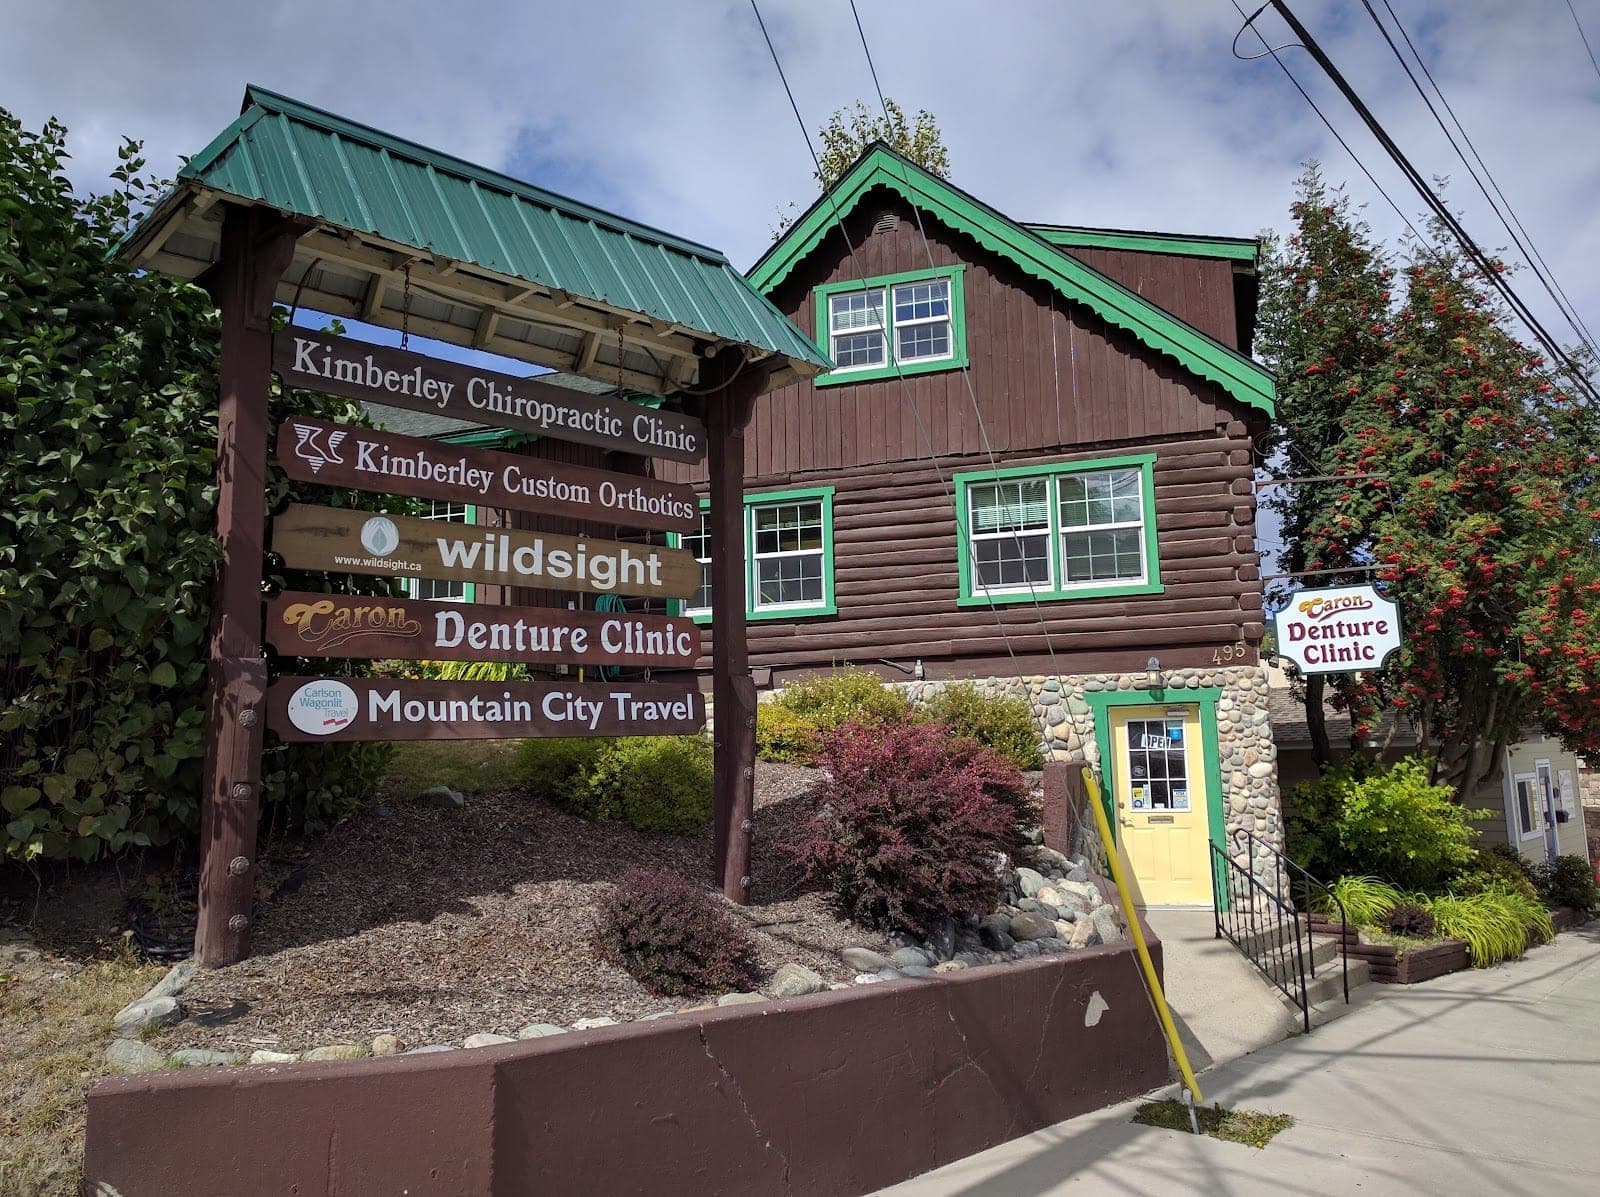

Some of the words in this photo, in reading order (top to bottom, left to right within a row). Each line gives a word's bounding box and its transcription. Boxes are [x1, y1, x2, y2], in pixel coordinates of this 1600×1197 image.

[292, 337, 454, 408] Kimberley
[467, 377, 622, 437] Chiropractic
[632, 415, 697, 452] Clinic
[355, 440, 494, 494] Kimberley
[503, 466, 591, 504] Custom
[599, 481, 694, 519] Orthotics
[334, 555, 422, 571] www.wildsight.ca
[436, 533, 662, 590] wildsight
[1299, 595, 1370, 620] Caron
[283, 600, 418, 645] Caron
[434, 610, 588, 654] Denture
[600, 620, 692, 656] Clinic
[1288, 619, 1389, 642] Denture
[1212, 642, 1246, 665] 495
[1304, 641, 1376, 665] Clinic
[299, 698, 342, 710] Wagonlit
[304, 688, 342, 698] Carlson
[323, 708, 349, 718] Travel
[368, 689, 531, 722] Mountain
[542, 691, 604, 730] City
[609, 692, 694, 721] Travel
